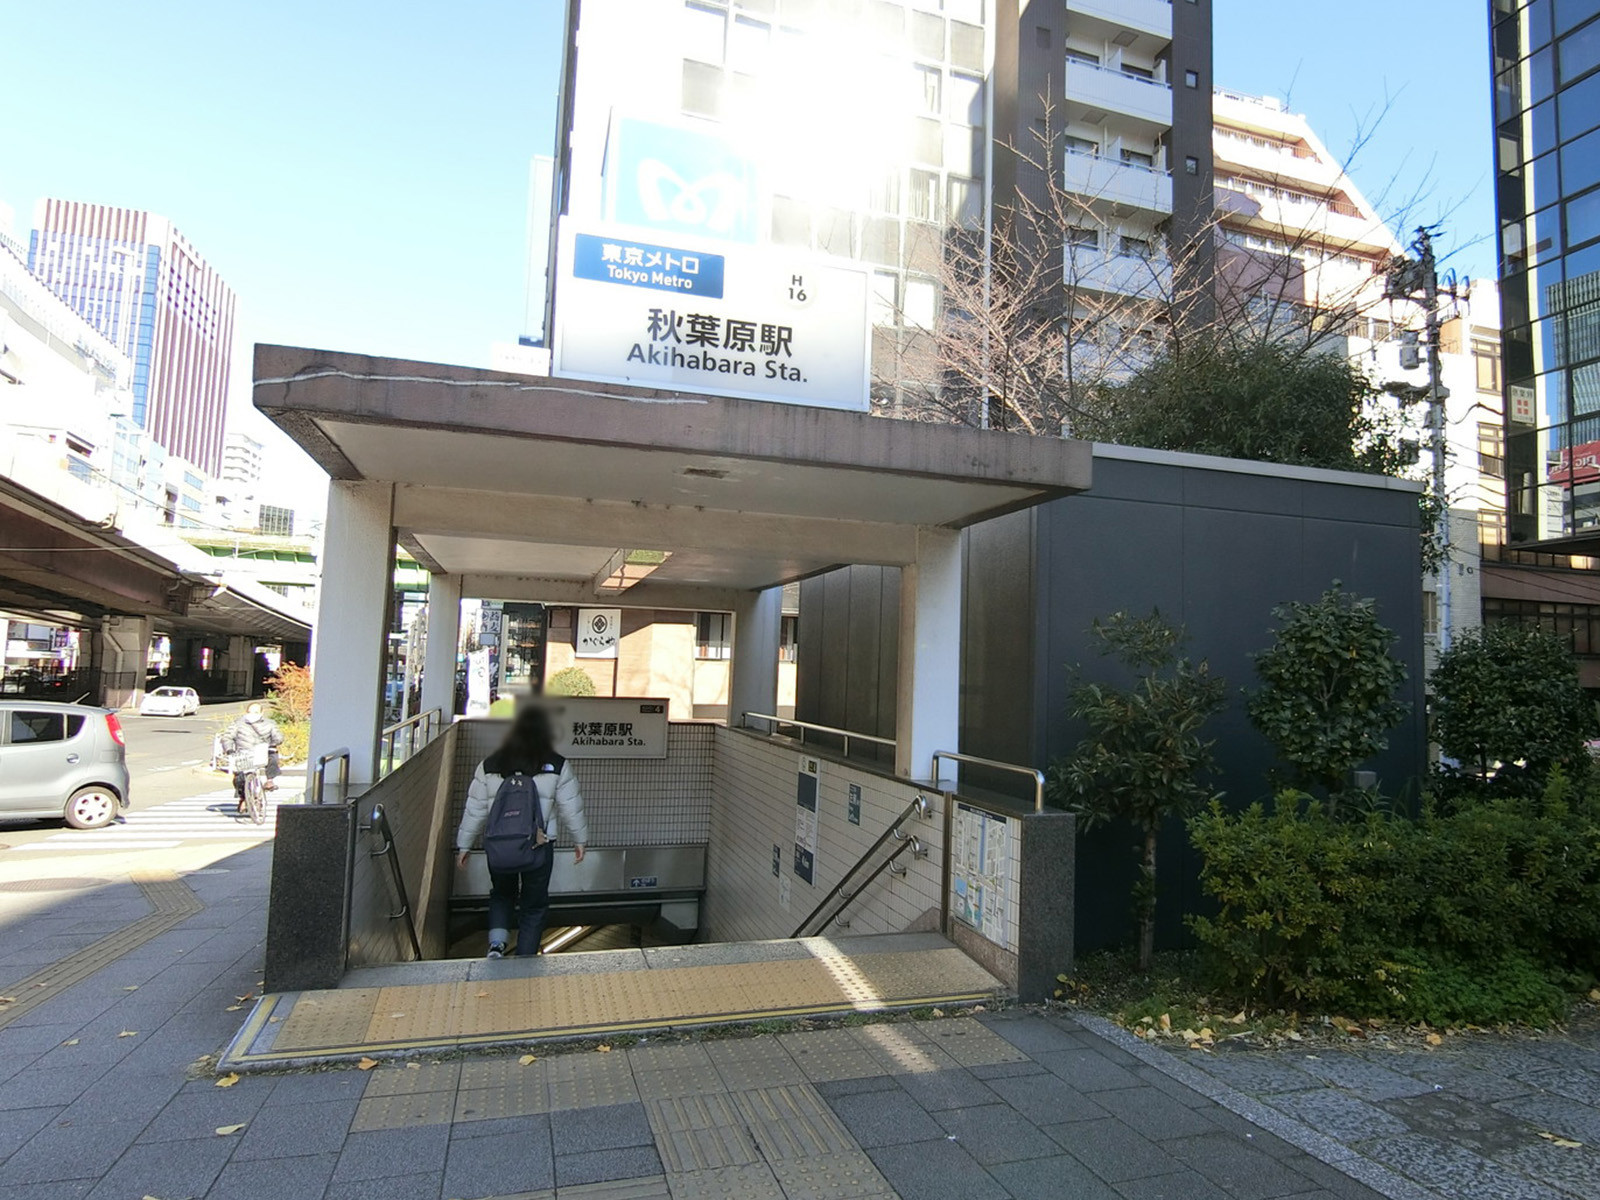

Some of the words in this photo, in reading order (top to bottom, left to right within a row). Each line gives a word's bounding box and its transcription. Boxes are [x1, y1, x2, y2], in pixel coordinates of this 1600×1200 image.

[601, 244, 699, 274] 東京メトロ
[607, 264, 649, 284] Tokyo
[652, 271, 693, 289] Metro
[792, 274, 802, 286] H
[789, 287, 807, 302] 16
[647, 308, 793, 358] 秋葉原駅
[626, 343, 756, 377] Akihabara
[765, 360, 808, 383] Sta.
[573, 722, 633, 736] 秋葉原駅
[572, 737, 625, 746] Akihabara
[627, 737, 646, 746] Sta.
